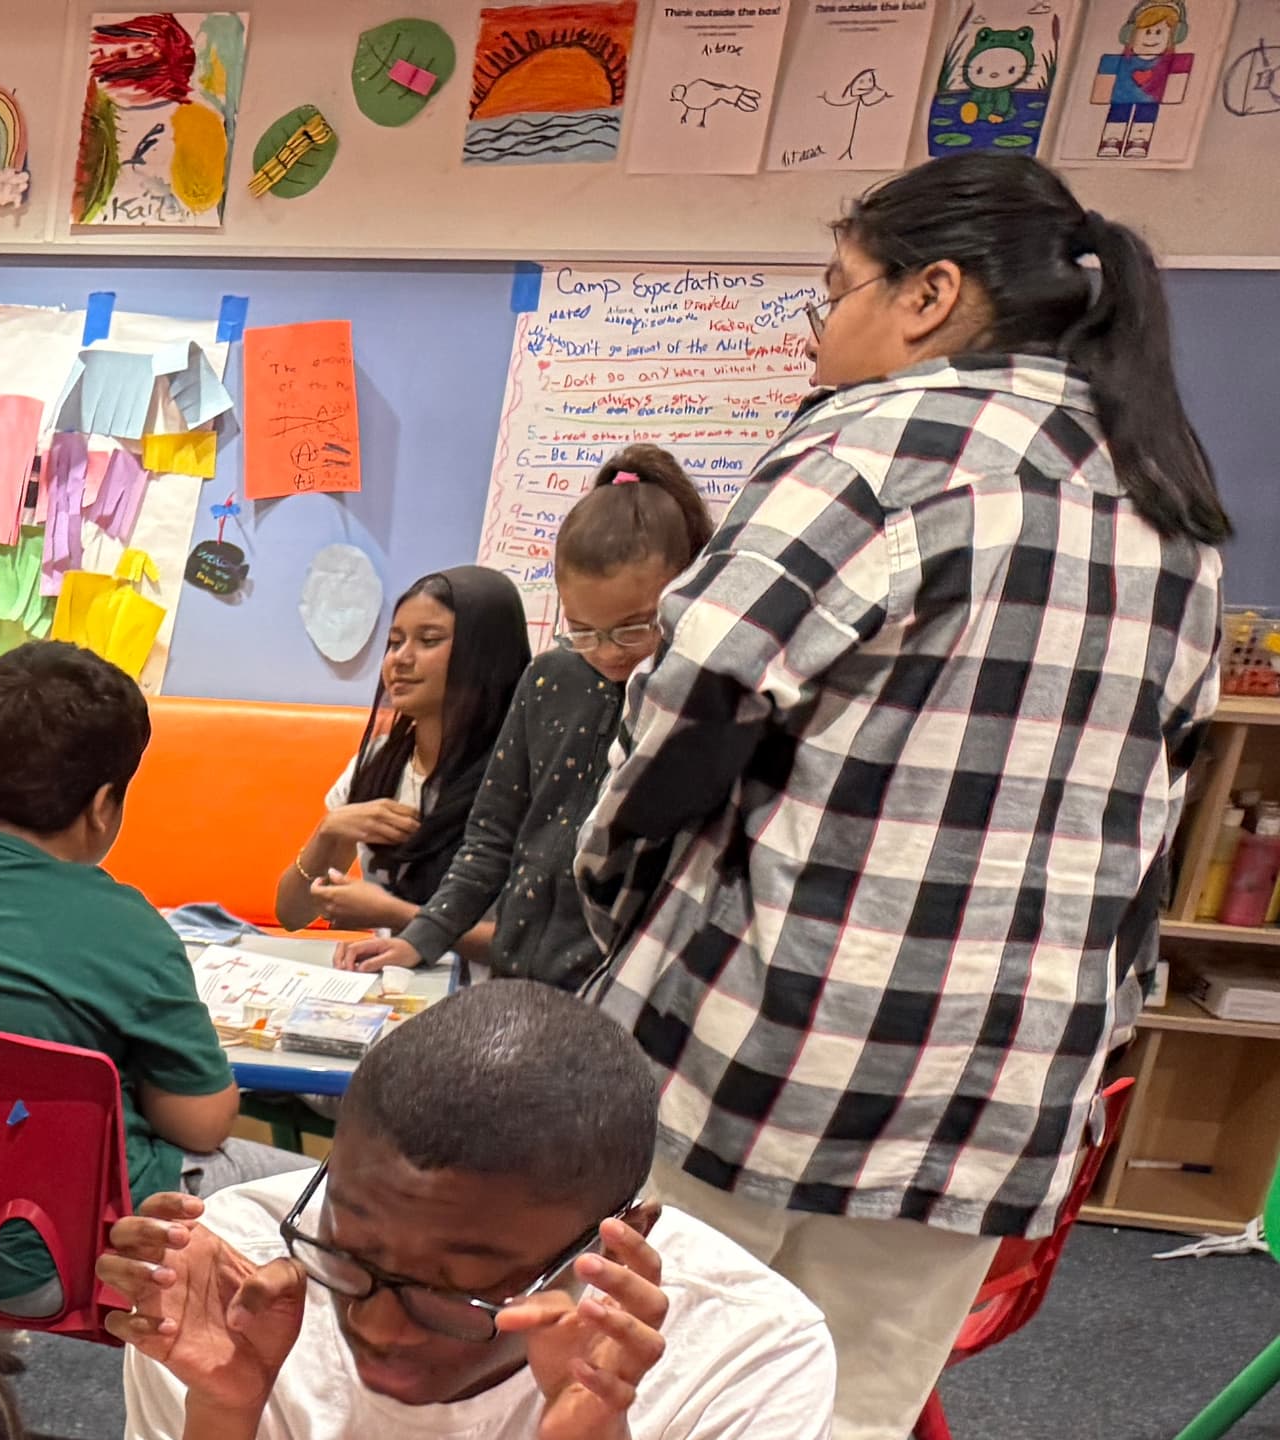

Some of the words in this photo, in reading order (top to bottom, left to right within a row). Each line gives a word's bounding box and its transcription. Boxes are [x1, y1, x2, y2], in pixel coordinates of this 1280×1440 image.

[664, 8, 691, 17] Think
[695, 8, 736, 17] outside
[739, 7, 756, 16] the
[758, 6, 781, 16] box!
[838, 3, 880, 13] outside
[881, 2, 900, 12] the
[557, 267, 621, 302] Camp
[633, 269, 764, 303] Expectations
[668, 340, 683, 354] of
[687, 339, 708, 354] the
